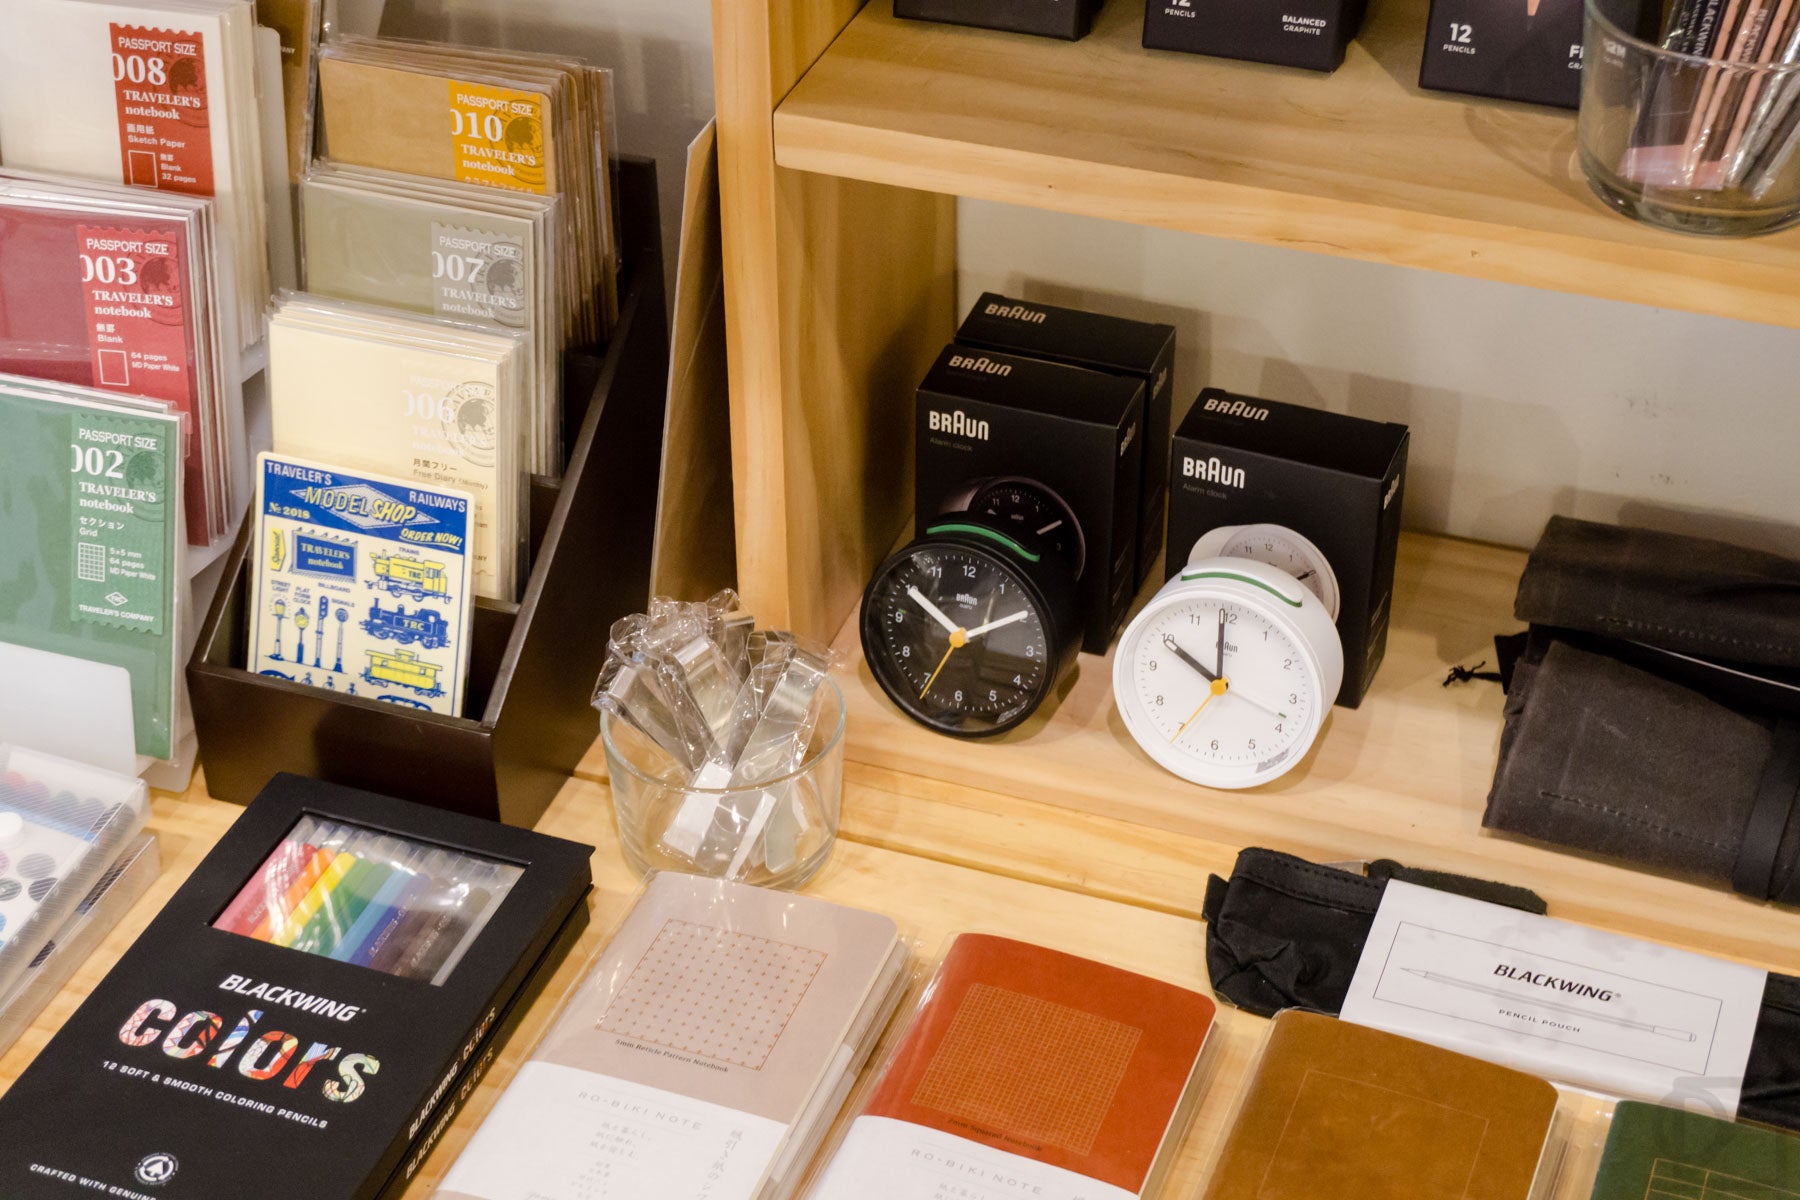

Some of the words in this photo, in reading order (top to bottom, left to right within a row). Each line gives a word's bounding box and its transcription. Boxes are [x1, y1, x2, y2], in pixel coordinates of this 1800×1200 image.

[1165, 8, 1196, 18] PENCILS
[1282, 15, 1326, 28] BALANCED
[1283, 24, 1321, 36] GRAPHITE
[1450, 23, 1473, 43] 12
[118, 36, 171, 54] PASSPORT
[174, 43, 197, 56] SIZE
[1443, 44, 1476, 55] PENCILS
[123, 90, 201, 108] TRAVELER'S
[456, 93, 509, 112] PASSPORT
[511, 102, 533, 117] SIZE
[125, 106, 180, 120] notebook
[127, 135, 158, 145] Sketch
[160, 138, 186, 148] Paper
[460, 143, 536, 166] TRAVELER'S
[462, 158, 515, 177] notebook
[86, 238, 143, 253] PASSPORT
[145, 243, 169, 256] SIZE
[439, 236, 492, 252] PASSPORT
[494, 244, 515, 259] SIZE
[92, 289, 174, 307] TRAVELER'S
[441, 286, 517, 310] TRAVELER'S
[94, 306, 152, 319] notebook
[442, 302, 496, 320] notebook
[984, 303, 1047, 324] BRAUN
[97, 334, 123, 344] Blank
[948, 355, 1012, 377] BRAUN
[1204, 398, 1270, 421] BRAUN
[929, 410, 990, 441] BRAUN
[79, 428, 133, 447] PASSPORT
[134, 436, 157, 450] SIZE
[266, 462, 332, 486] TRAVELER'S
[413, 469, 432, 479] Free
[434, 472, 456, 484] Diary
[1183, 456, 1246, 489] BRAUN
[79, 481, 157, 503] TRAVELER'S
[79, 497, 134, 515] notebook
[305, 486, 369, 516] MODEL
[372, 499, 416, 524] SHOP
[409, 490, 466, 513] RAILWAYS
[79, 516, 125, 530] セクション
[79, 527, 98, 538] Grid
[401, 528, 434, 542] ORDER
[434, 533, 463, 546] NOW!
[1244, 546, 1253, 554] 11
[1264, 543, 1274, 552] 12
[930, 566, 942, 579] 11
[962, 565, 976, 578] 12
[1000, 583, 1005, 594] 1
[120, 611, 154, 622] COMPANY
[895, 611, 903, 623] 9
[1189, 614, 1201, 626] 11
[1225, 613, 1238, 625] 12
[403, 619, 424, 631] TRC
[1262, 630, 1268, 641] 1
[902, 646, 910, 657] 8
[1026, 645, 1034, 657] 3
[1149, 661, 1157, 672] 9
[1283, 659, 1292, 670] 2
[923, 672, 931, 683] 7
[1013, 674, 1021, 686] 4
[954, 690, 963, 702] 6
[988, 690, 997, 702] 5
[1156, 695, 1164, 706] 8
[1289, 694, 1297, 705] 3
[1275, 724, 1283, 734] 4
[1211, 740, 1219, 750] 6
[1248, 739, 1256, 750] 5
[1493, 963, 1612, 1003] BLACKWING
[219, 974, 360, 1022] BLACKWING
[1499, 1008, 1537, 1024] PENCIL
[1541, 1018, 1581, 1034] POUCH
[663, 1050, 692, 1063] Pattern
[693, 1058, 729, 1073] Notebook
[120, 1065, 150, 1079] SOFT
[151, 1073, 160, 1083] &
[163, 1077, 213, 1097] SMOOTH
[215, 1091, 276, 1114] COLORING
[277, 1108, 328, 1130] PENCILS
[409, 1062, 459, 1140] BLACKWING
[655, 1111, 703, 1131] NOTE
[406, 1102, 456, 1180] BLACKWING
[29, 1163, 77, 1182] CRAFTED
[79, 1177, 107, 1191] WITH
[993, 1173, 1043, 1195] NOTE
